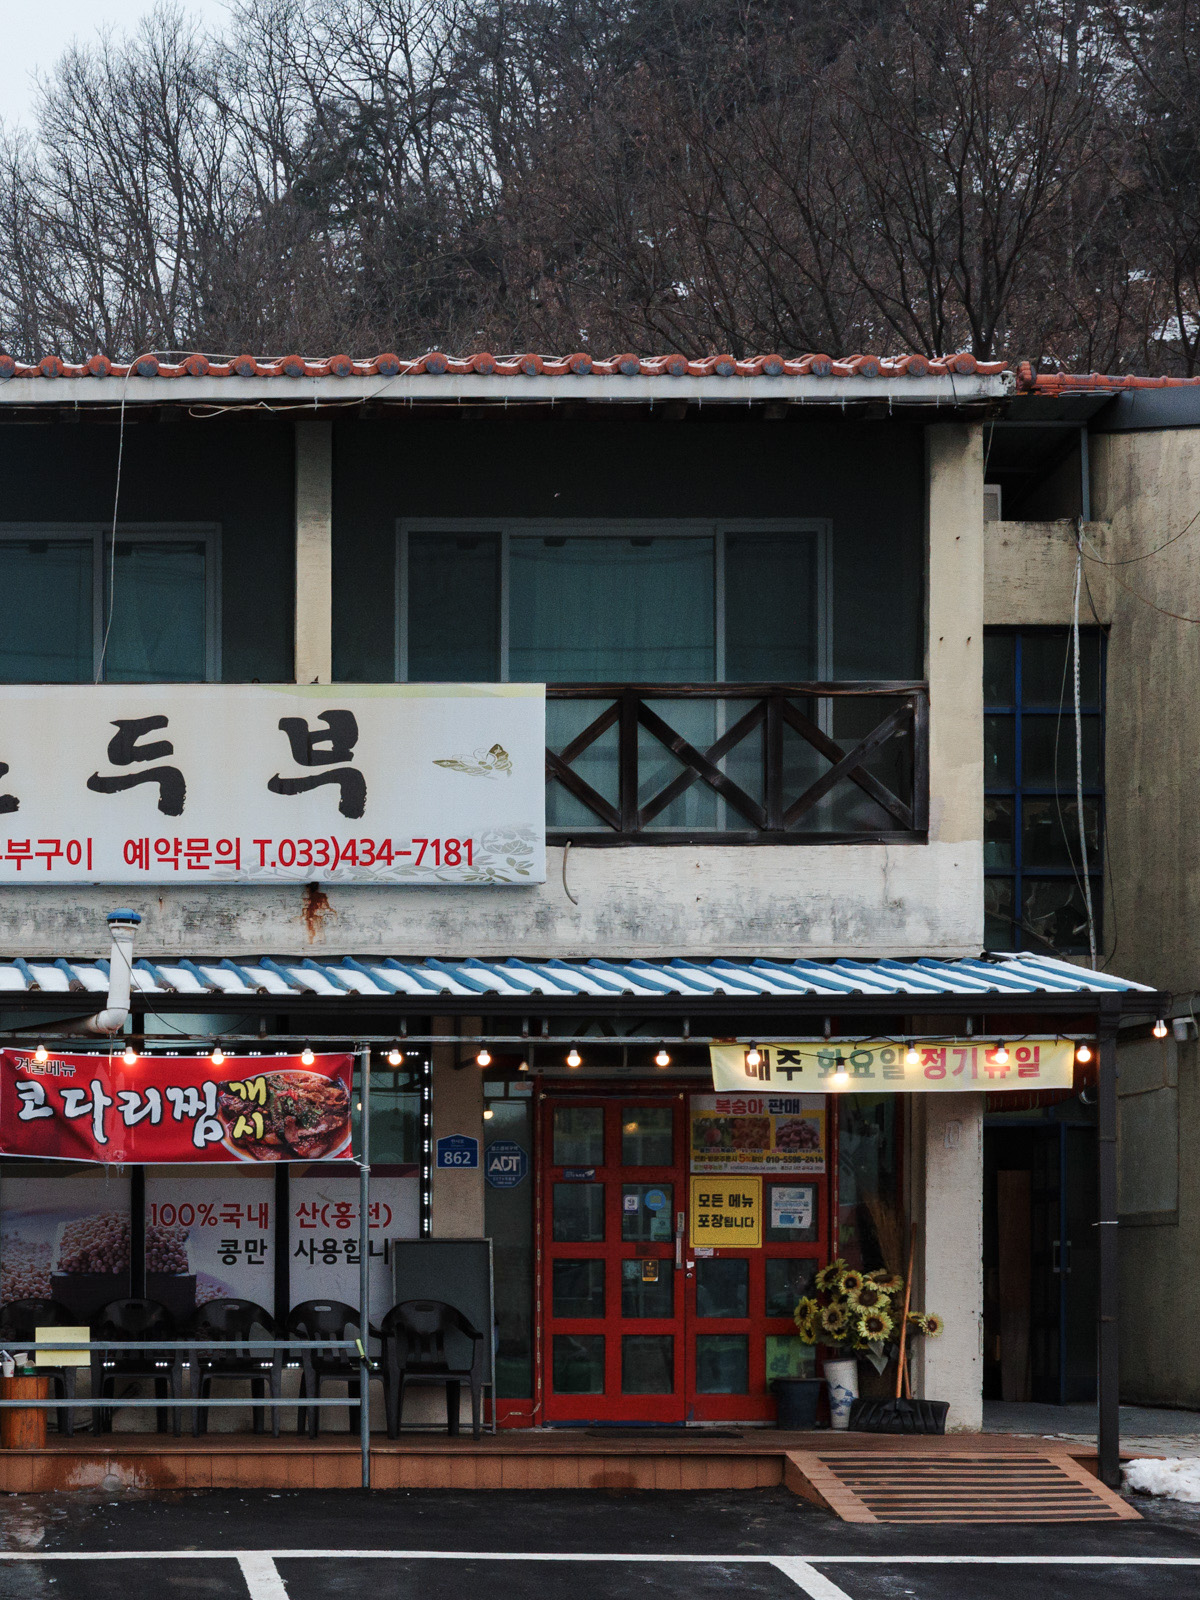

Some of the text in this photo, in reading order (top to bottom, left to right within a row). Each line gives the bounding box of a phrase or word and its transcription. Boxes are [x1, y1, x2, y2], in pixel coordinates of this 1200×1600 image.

[123, 837, 241, 871] 예약문의
[252, 835, 473, 872] T.033)434-7181
[14, 1056, 76, 1077] 겨울메뉴
[744, 1048, 803, 1081] 매주
[921, 1045, 1041, 1080] 정기휴일
[15, 1079, 225, 1149] 코다리찜
[716, 1098, 800, 1115] 복숭아 판매
[443, 1151, 472, 1165] 862
[489, 1156, 521, 1171] ADT
[698, 1193, 754, 1208] 모든 메뉴
[698, 1213, 755, 1228] 포장됩니다
[217, 1238, 268, 1265] 콩만
